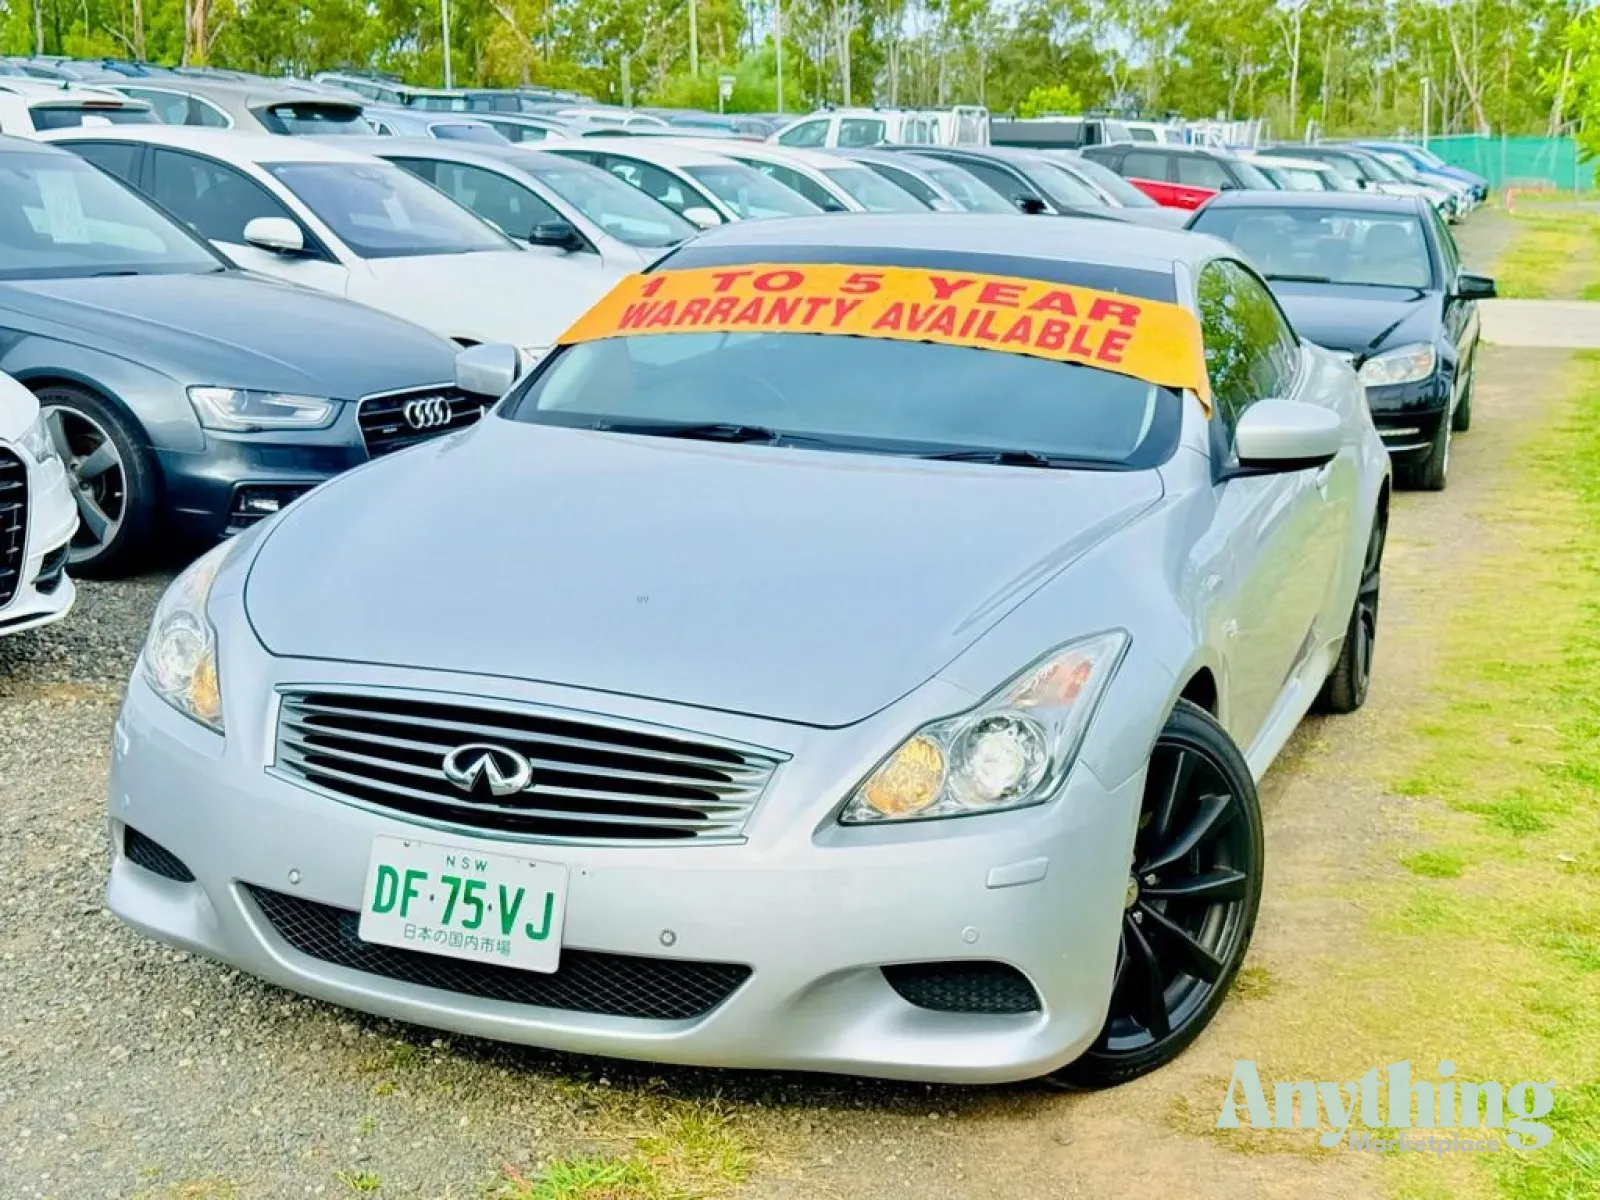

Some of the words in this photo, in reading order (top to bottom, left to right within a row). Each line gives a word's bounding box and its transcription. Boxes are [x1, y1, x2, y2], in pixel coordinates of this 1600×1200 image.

[639, 275, 665, 299] 1
[711, 270, 805, 293] TO
[838, 272, 883, 294] 5
[929, 276, 1143, 328] YEAR
[617, 296, 862, 329] WARRANTY
[871, 301, 1134, 365] AVAILABLE
[445, 855, 488, 872] NSW
